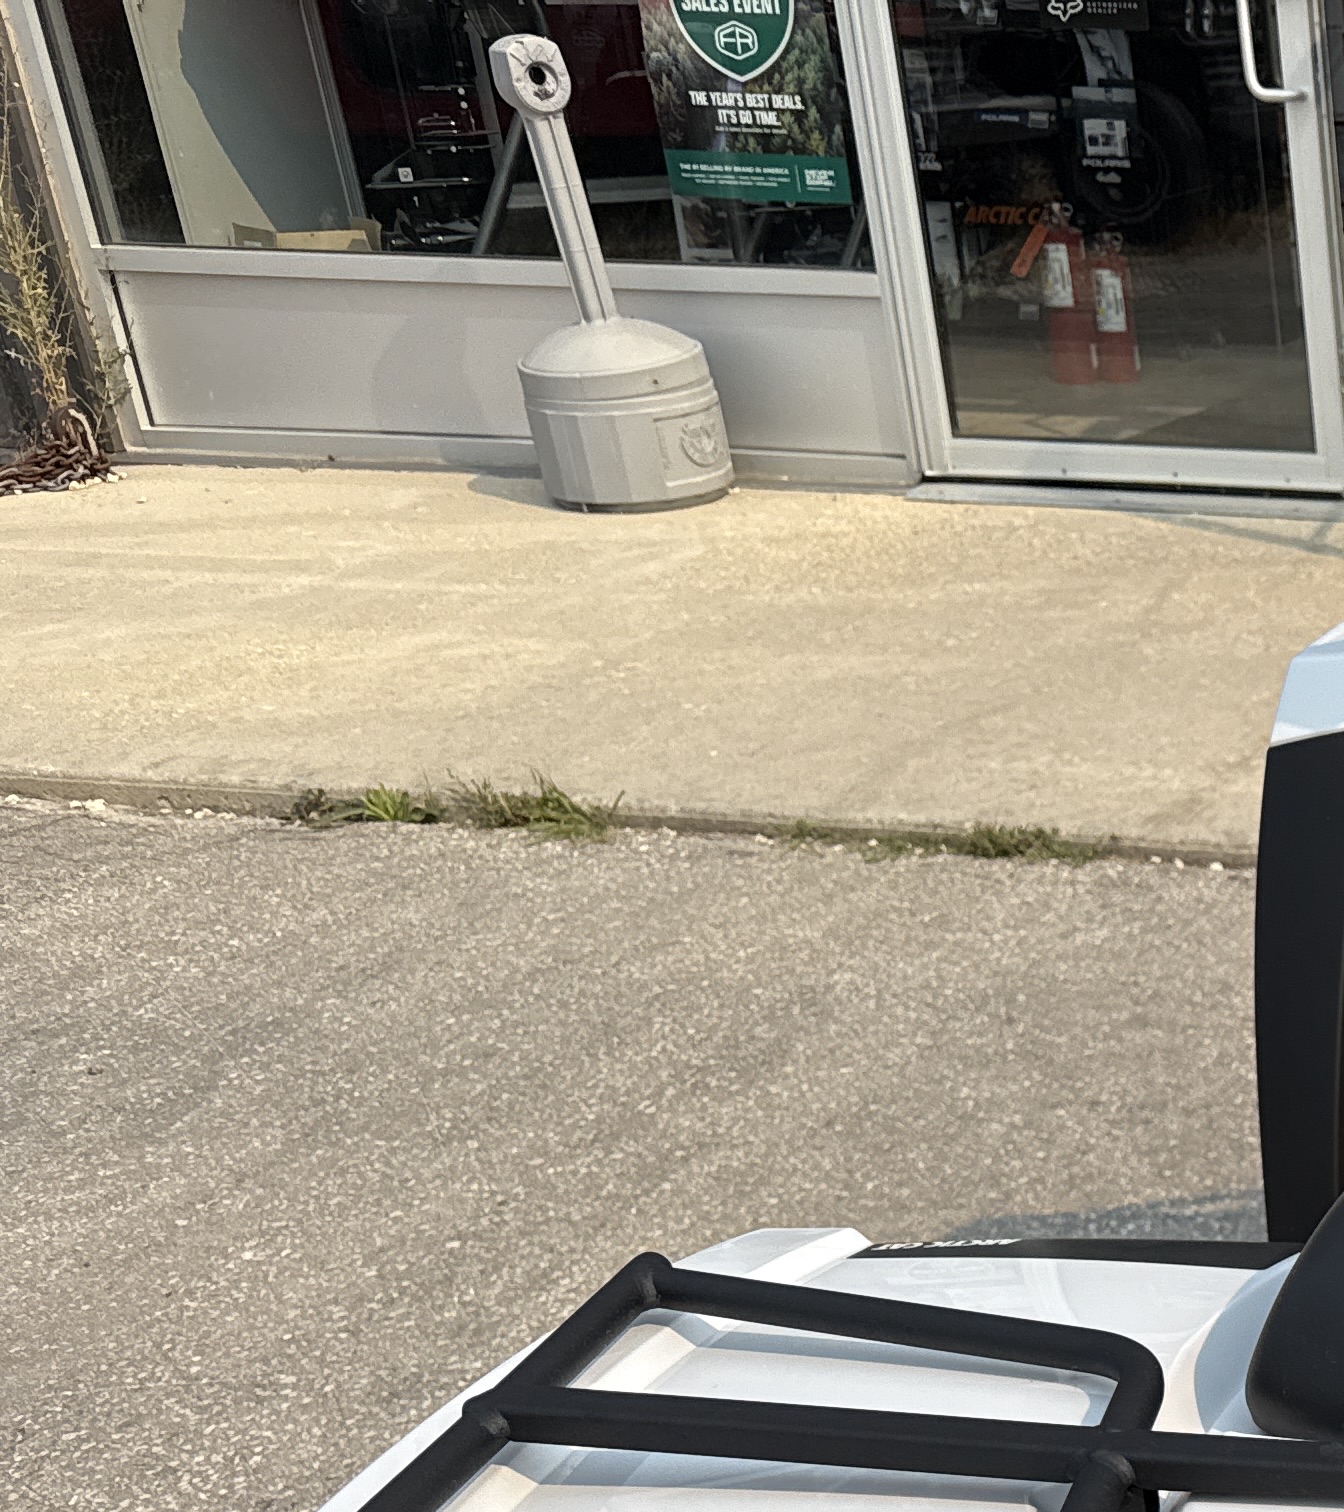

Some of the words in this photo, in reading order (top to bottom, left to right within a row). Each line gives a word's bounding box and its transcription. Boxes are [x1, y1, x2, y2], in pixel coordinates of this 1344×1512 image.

[734, 0, 781, 15] EVENT
[689, 91, 709, 106] THE
[711, 92, 744, 107] YEAR'S
[746, 93, 770, 108] BEST
[772, 94, 805, 110] DEALS.
[718, 110, 737, 124] IT'S
[740, 111, 753, 125] GO
[964, 206, 1026, 224] ARCTIC
